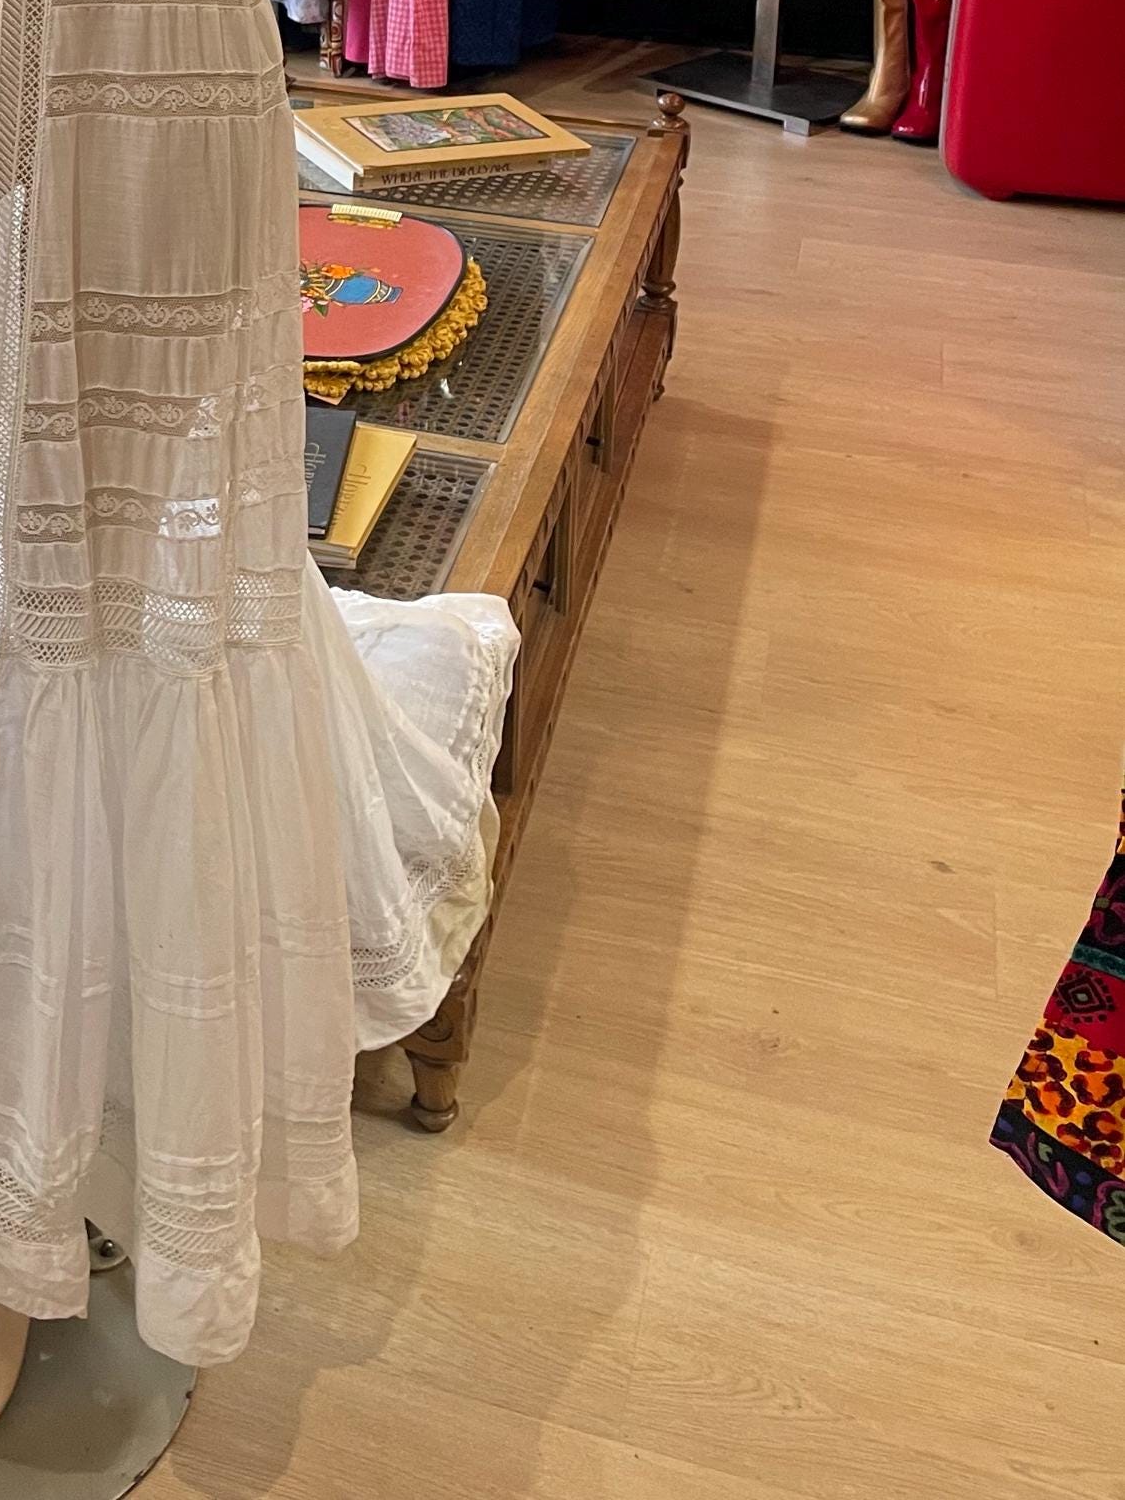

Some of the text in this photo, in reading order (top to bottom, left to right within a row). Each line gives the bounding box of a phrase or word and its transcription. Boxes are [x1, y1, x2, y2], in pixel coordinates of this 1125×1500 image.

[381, 170, 426, 185] WHERE
[428, 169, 452, 181] THE
[488, 162, 514, 174] ARE
